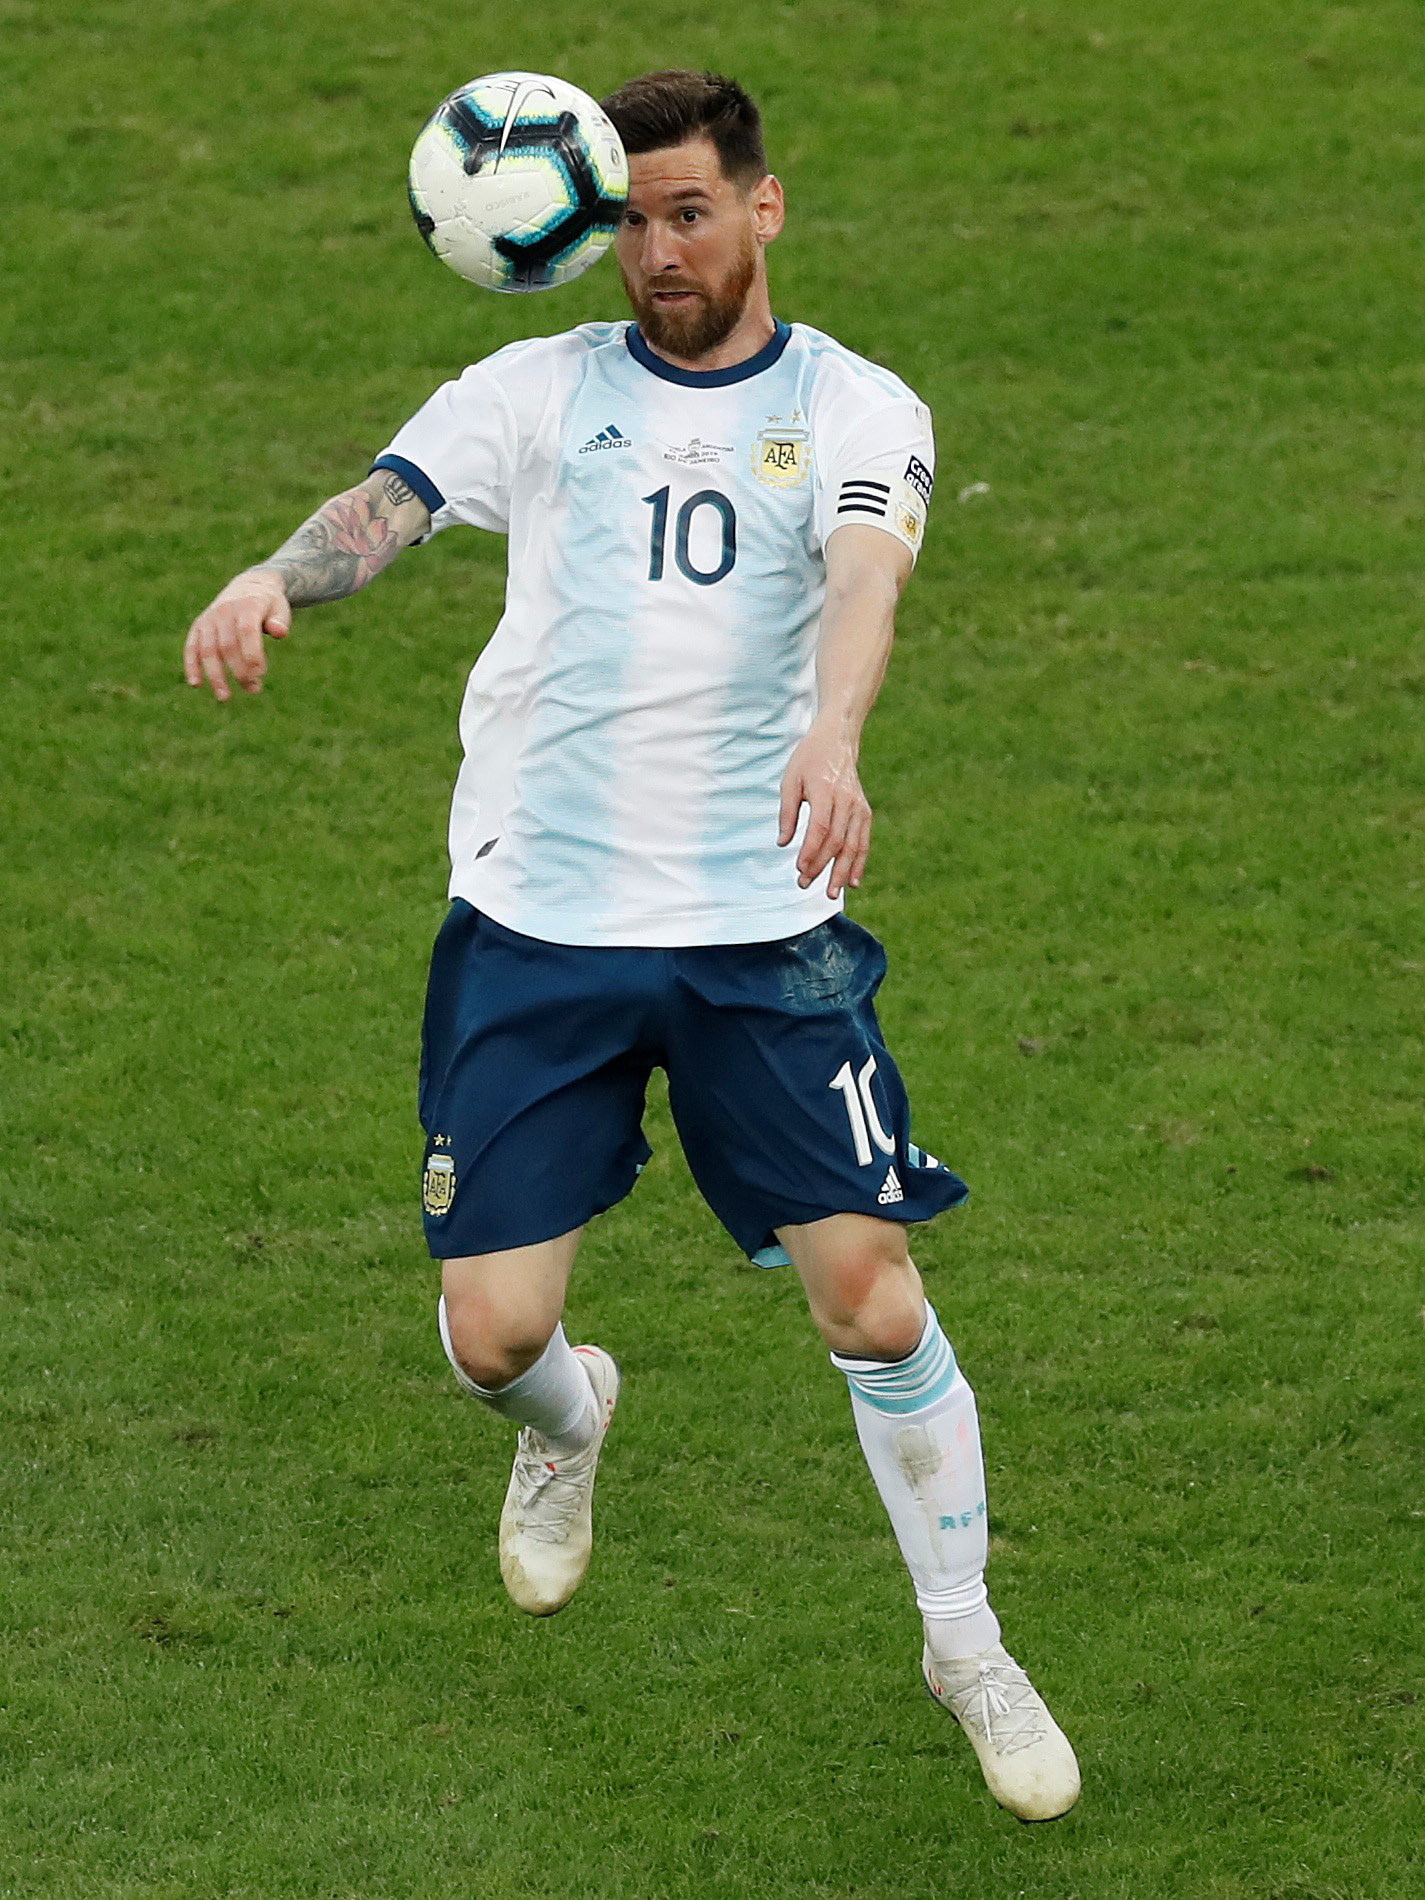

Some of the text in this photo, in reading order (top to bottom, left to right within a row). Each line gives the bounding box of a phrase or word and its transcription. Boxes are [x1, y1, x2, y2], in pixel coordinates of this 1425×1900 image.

[578, 438, 632, 454] adidas
[764, 442, 797, 470] AFA
[910, 459, 930, 488] Cree
[906, 473, 930, 505] gran
[641, 485, 736, 586] 10
